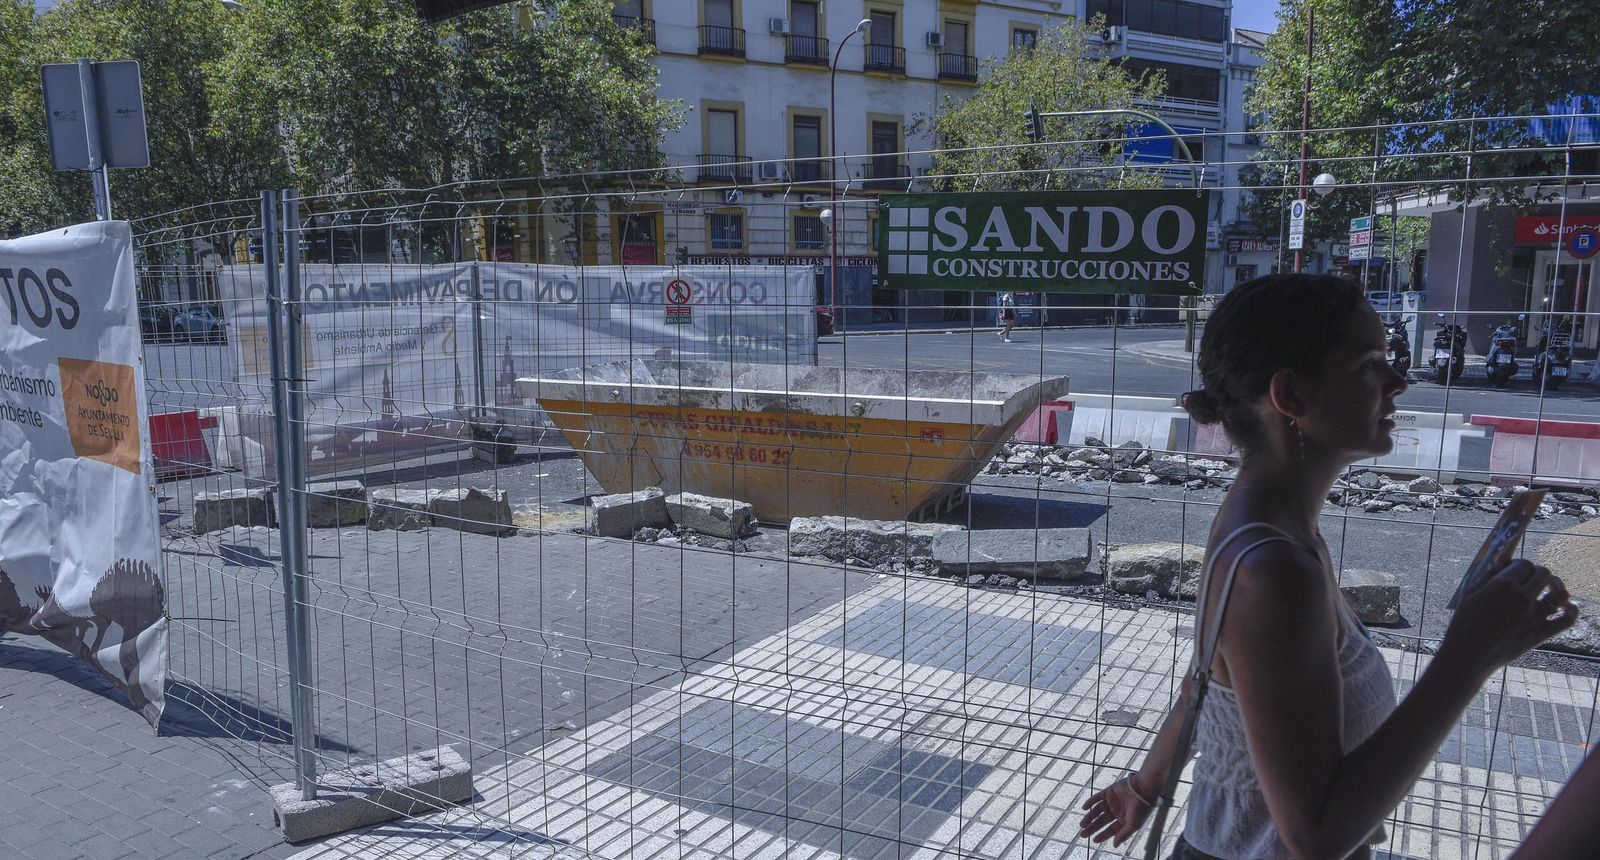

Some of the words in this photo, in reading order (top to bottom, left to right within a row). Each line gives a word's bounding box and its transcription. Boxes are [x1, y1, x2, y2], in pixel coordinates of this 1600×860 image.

[932, 204, 1196, 255] SANDO
[690, 257, 751, 266] REPUESTOS
[768, 257, 824, 266] BICICLETAS
[932, 258, 1190, 281] CONSTRUCCIONES
[78, 405, 130, 427] AYUNTAMIENTO
[88, 424, 98, 435] DE
[749, 447, 767, 463] 60
